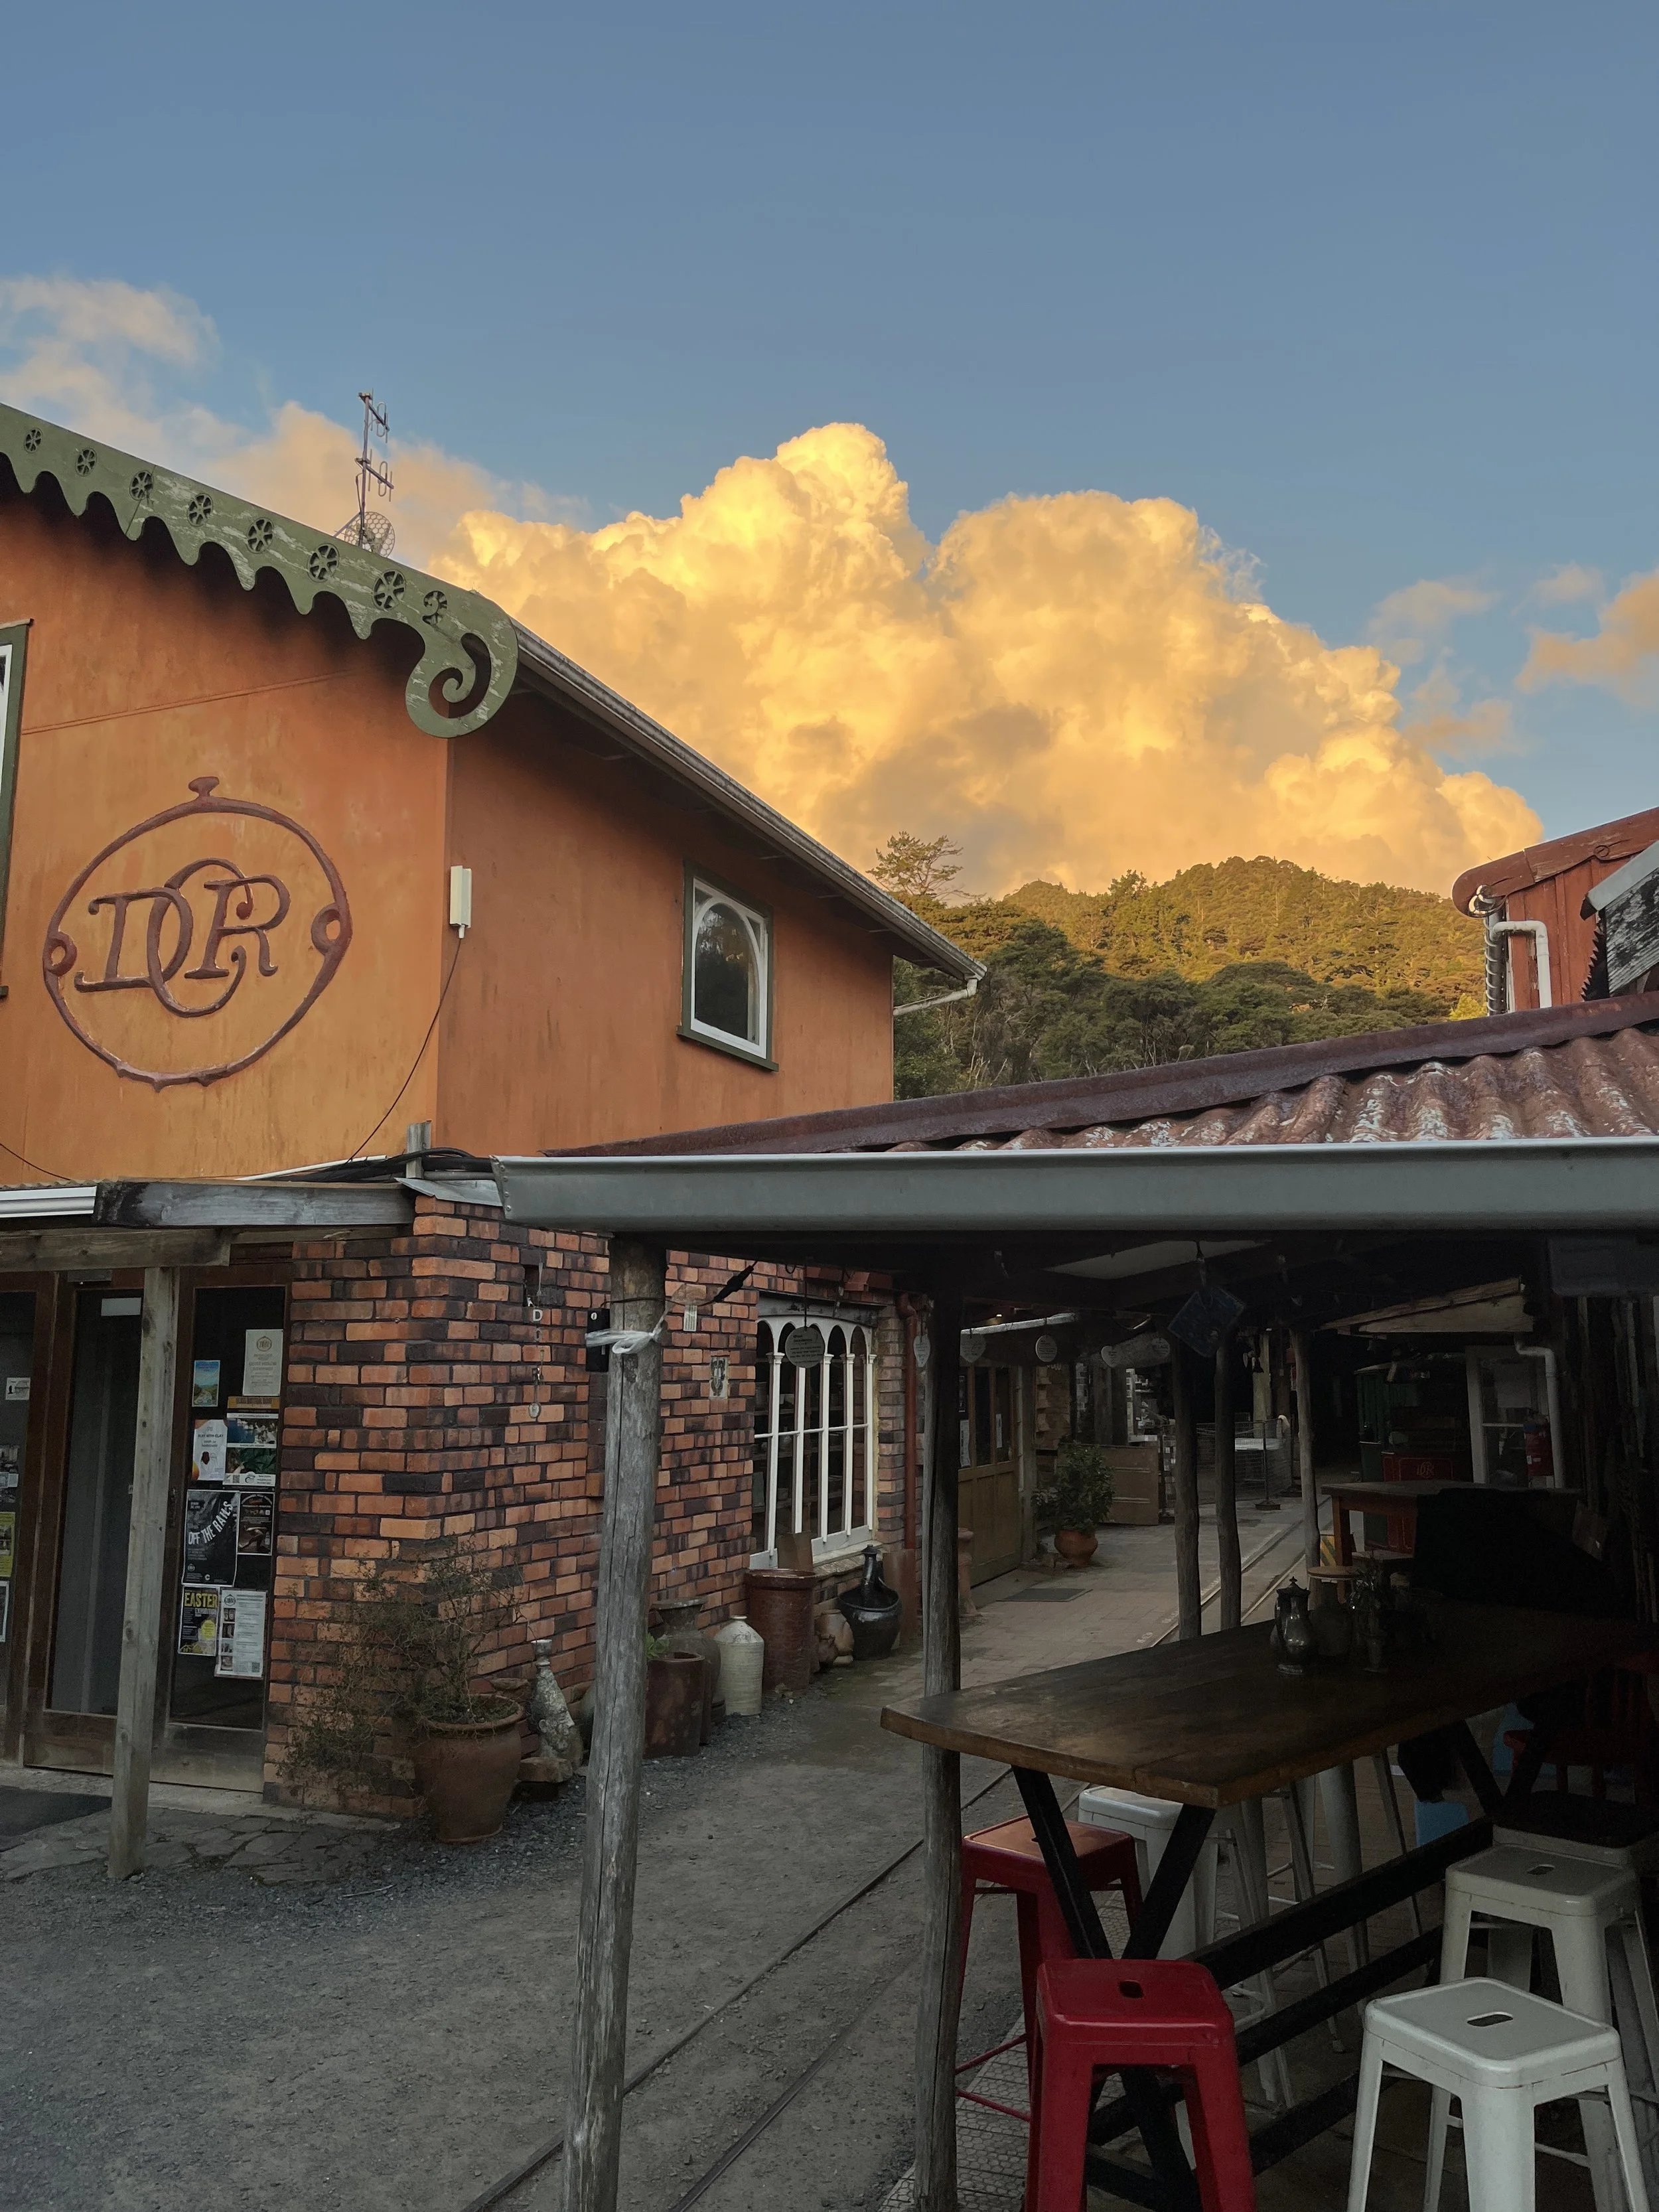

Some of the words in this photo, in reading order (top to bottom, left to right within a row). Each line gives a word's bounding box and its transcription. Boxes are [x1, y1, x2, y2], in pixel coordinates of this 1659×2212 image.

[188, 1531, 200, 1545] OFF
[200, 1524, 216, 1544] THE
[212, 1501, 234, 1532] RAILS
[184, 1592, 218, 1608] EASTER
